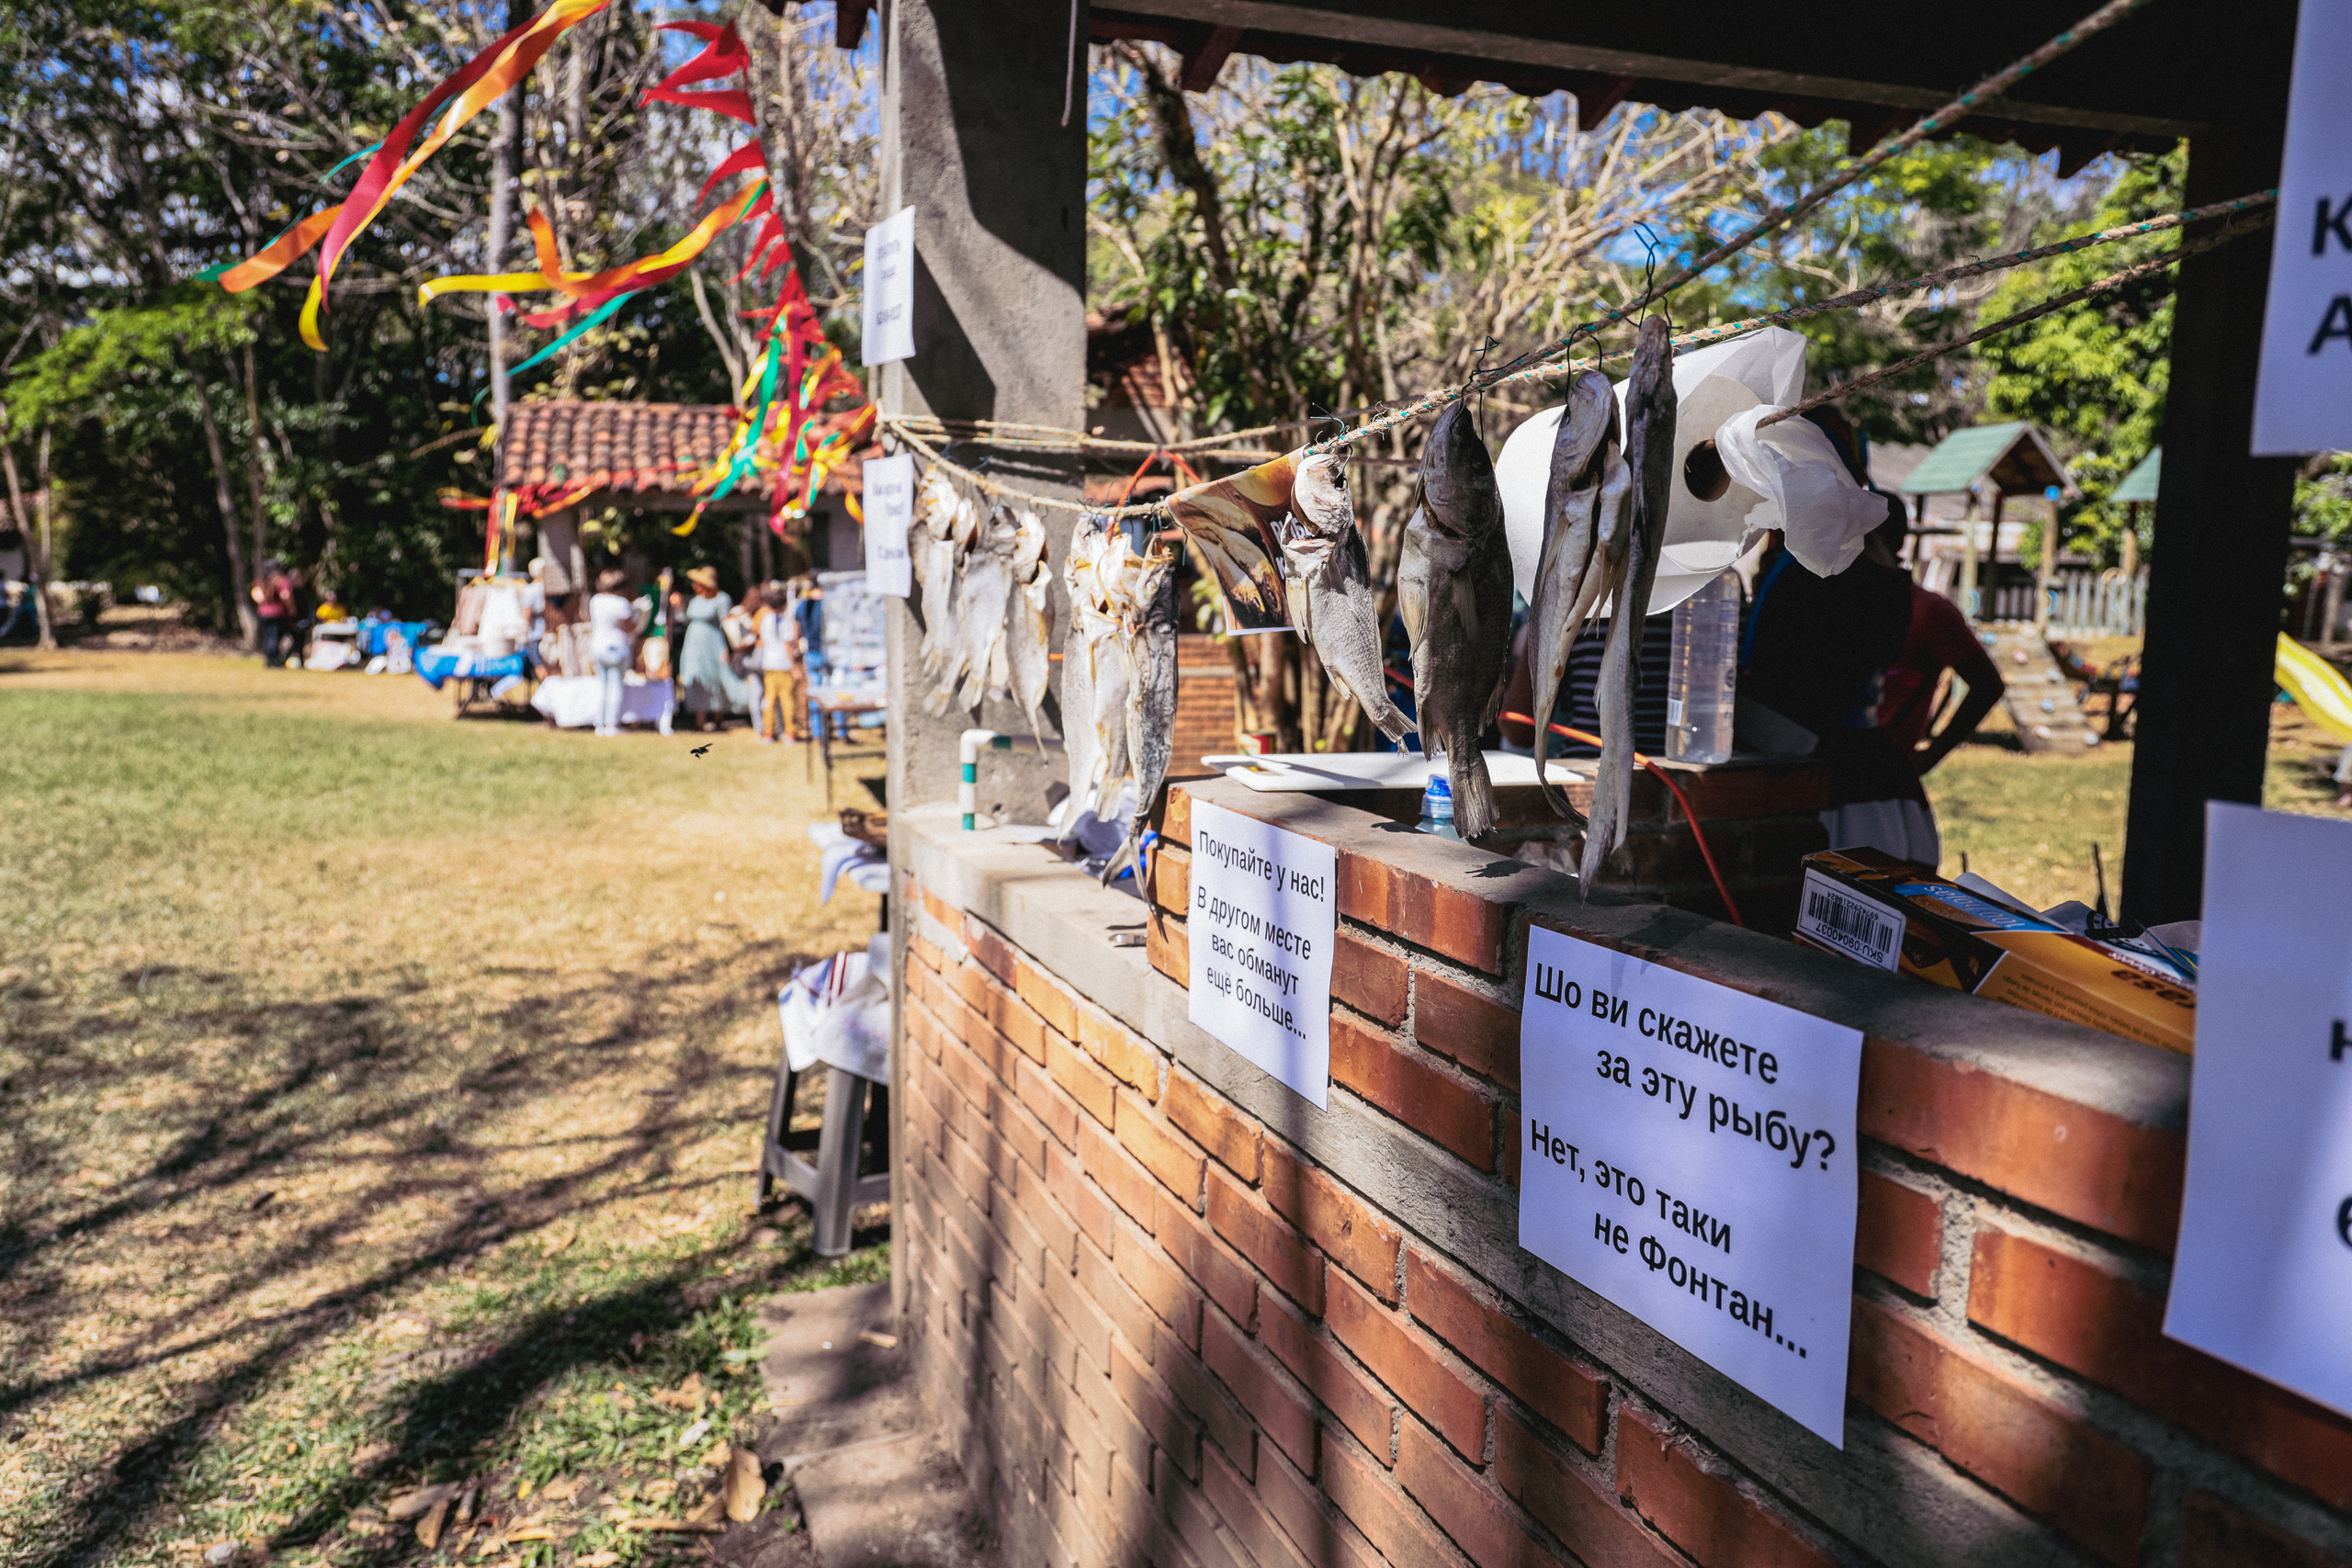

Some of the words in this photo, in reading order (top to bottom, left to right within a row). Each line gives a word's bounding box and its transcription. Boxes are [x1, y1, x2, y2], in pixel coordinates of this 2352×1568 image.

[1199, 829, 1272, 881] Покупайте
[1276, 864, 1285, 891] у
[1290, 869, 1324, 903] нас!
[1923, 885, 1986, 913] hojas
[1197, 886, 1207, 909] В
[1209, 895, 1261, 937] другом
[1265, 924, 1311, 961] месте
[1815, 922, 1884, 964] SKU:09040037
[1978, 909, 2025, 929] 100
[1212, 933, 1234, 960] вас
[1238, 942, 1299, 996] обманут
[1206, 965, 1232, 998] ещё
[1236, 978, 1306, 1041] больше...
[1534, 963, 1582, 1010] Шо
[1591, 988, 1629, 1029] ви
[1638, 1007, 1779, 1085] скажете
[1596, 1049, 1632, 1089] за
[1642, 1066, 1697, 1121] эту
[1708, 1092, 1836, 1171] рыбу?
[1531, 1119, 1585, 1183] Нет,
[1594, 1159, 1645, 1207] это
[1656, 1189, 1731, 1254] таки
[1594, 1212, 1629, 1255] не
[1639, 1235, 1807, 1359] Фонтан...
